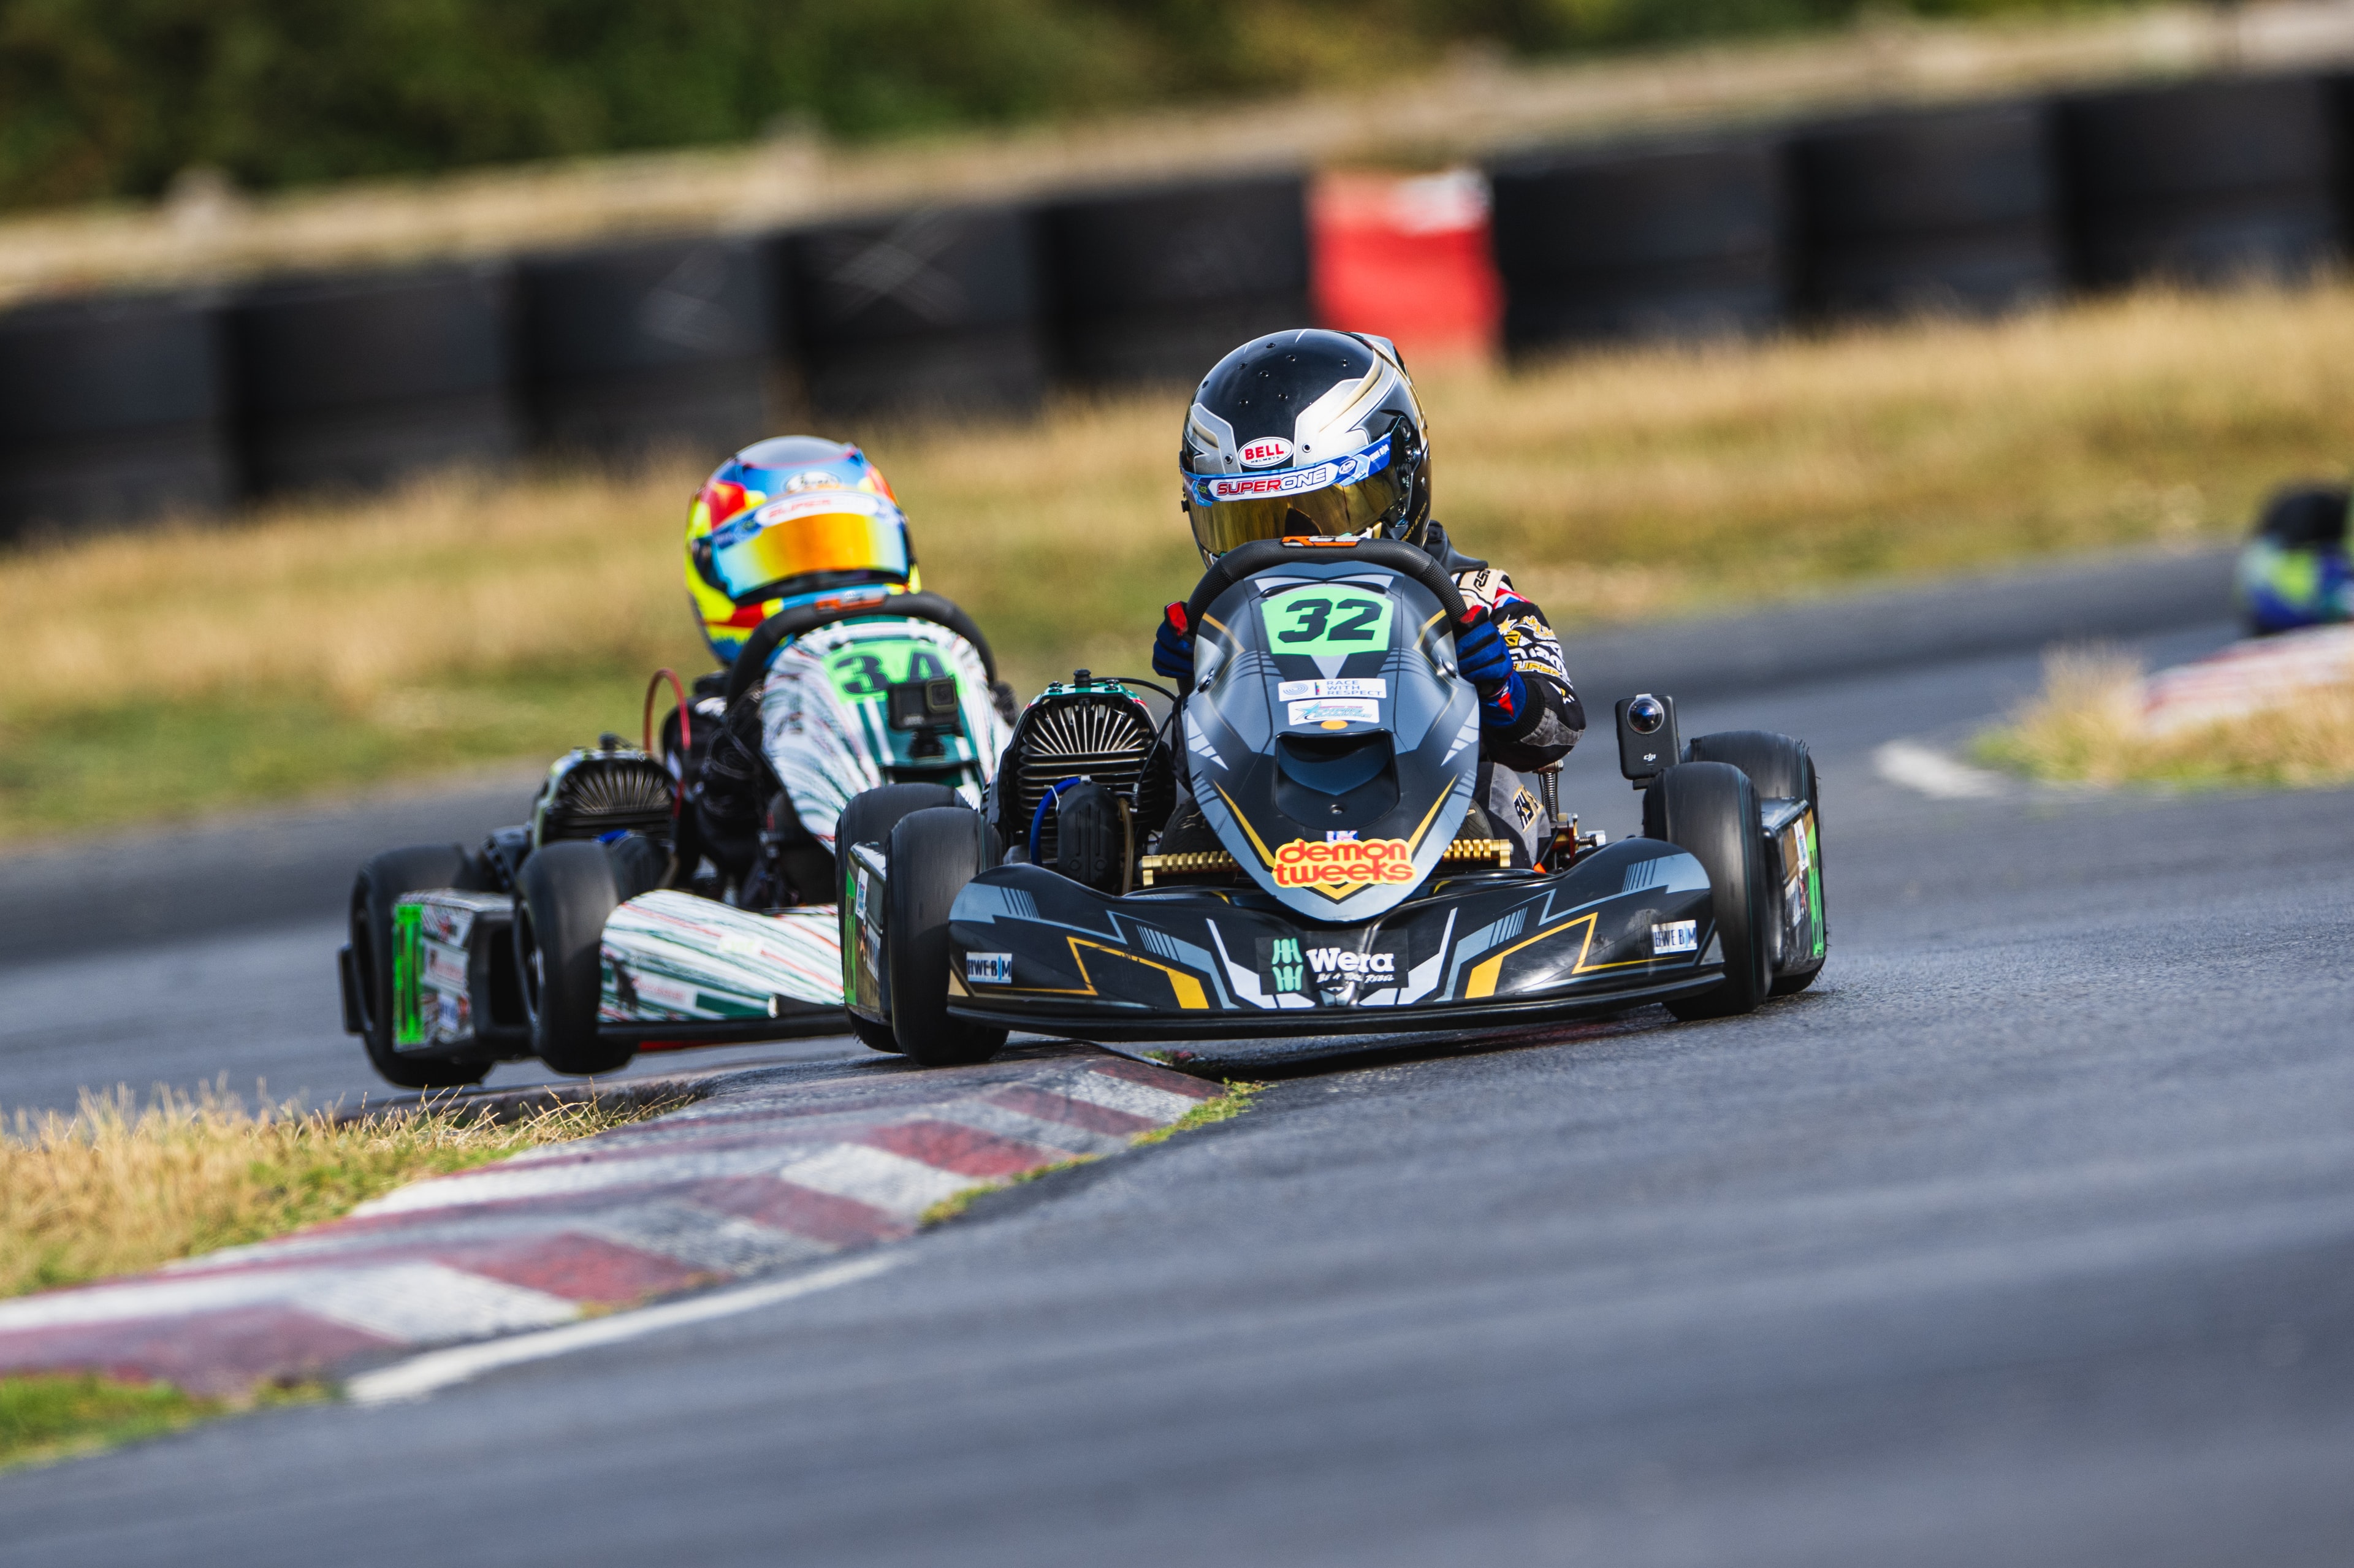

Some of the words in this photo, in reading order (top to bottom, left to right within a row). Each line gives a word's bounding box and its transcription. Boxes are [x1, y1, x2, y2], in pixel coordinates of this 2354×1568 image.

[1244, 444, 1284, 460] BELL
[1216, 467, 1327, 496] SUPERONE
[1277, 598, 1383, 643] 32
[1279, 841, 1407, 863] demon
[1274, 862, 1413, 885] tweeks
[1306, 948, 1395, 973] Wera
[1364, 974, 1395, 983] REBEL
